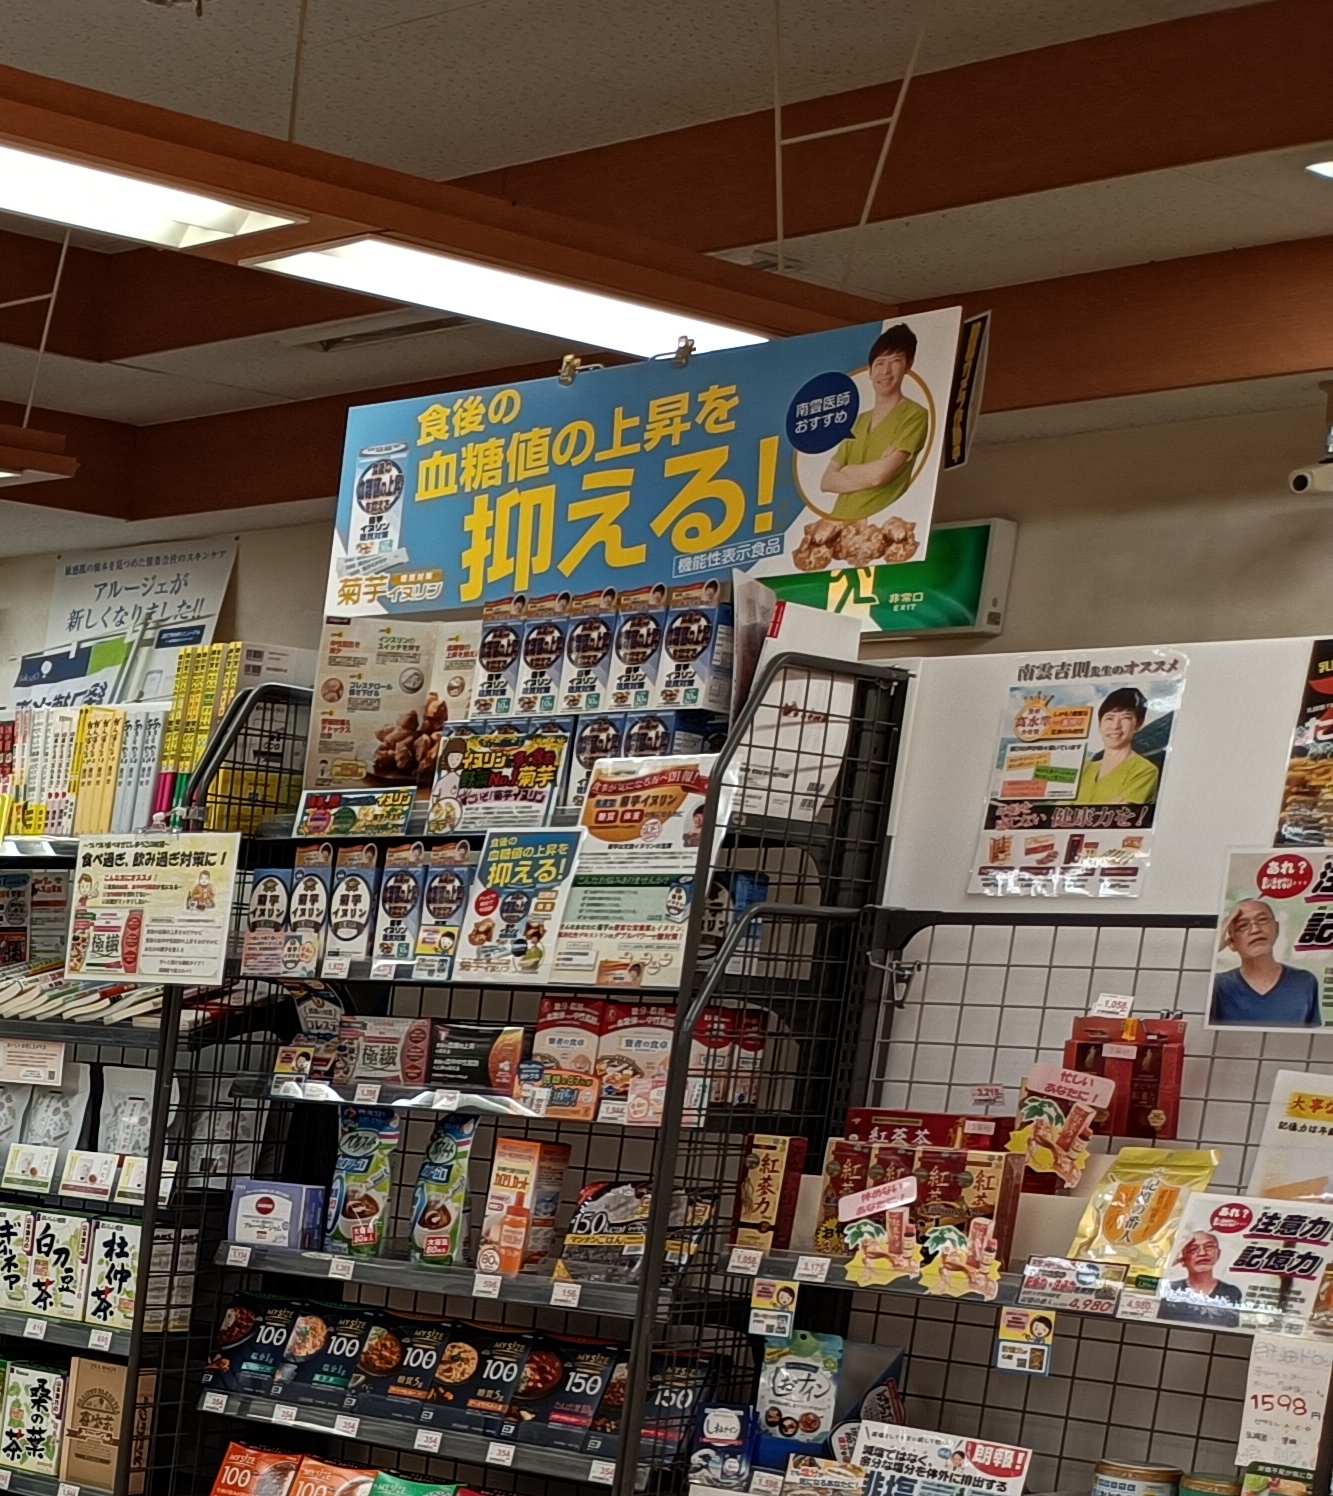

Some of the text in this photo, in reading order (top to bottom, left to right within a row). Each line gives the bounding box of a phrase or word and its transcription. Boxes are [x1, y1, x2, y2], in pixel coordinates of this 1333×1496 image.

[796, 391, 850, 418] 南雲医師
[416, 389, 521, 446] 食後の
[795, 410, 848, 434] おすすめ
[414, 385, 739, 502] 血糖値の上昇を
[460, 435, 780, 602] 抑える!
[676, 537, 781, 577] 機能性表示食品
[94, 573, 189, 600] アルージェが
[889, 592, 924, 603] 非常口
[893, 603, 917, 612] EXIT
[1249, 1212, 1330, 1240] 注意力
[1234, 1246, 1323, 1274] 記憶力
[255, 1326, 287, 1346] 100
[327, 1336, 359, 1357] 100
[403, 1348, 435, 1369] 100
[483, 1360, 518, 1382] 100
[566, 1372, 602, 1394] 150
[1251, 1394, 1308, 1416] 1598
[3, 1429, 24, 1461] 茶
[221, 1466, 251, 1487] 100
